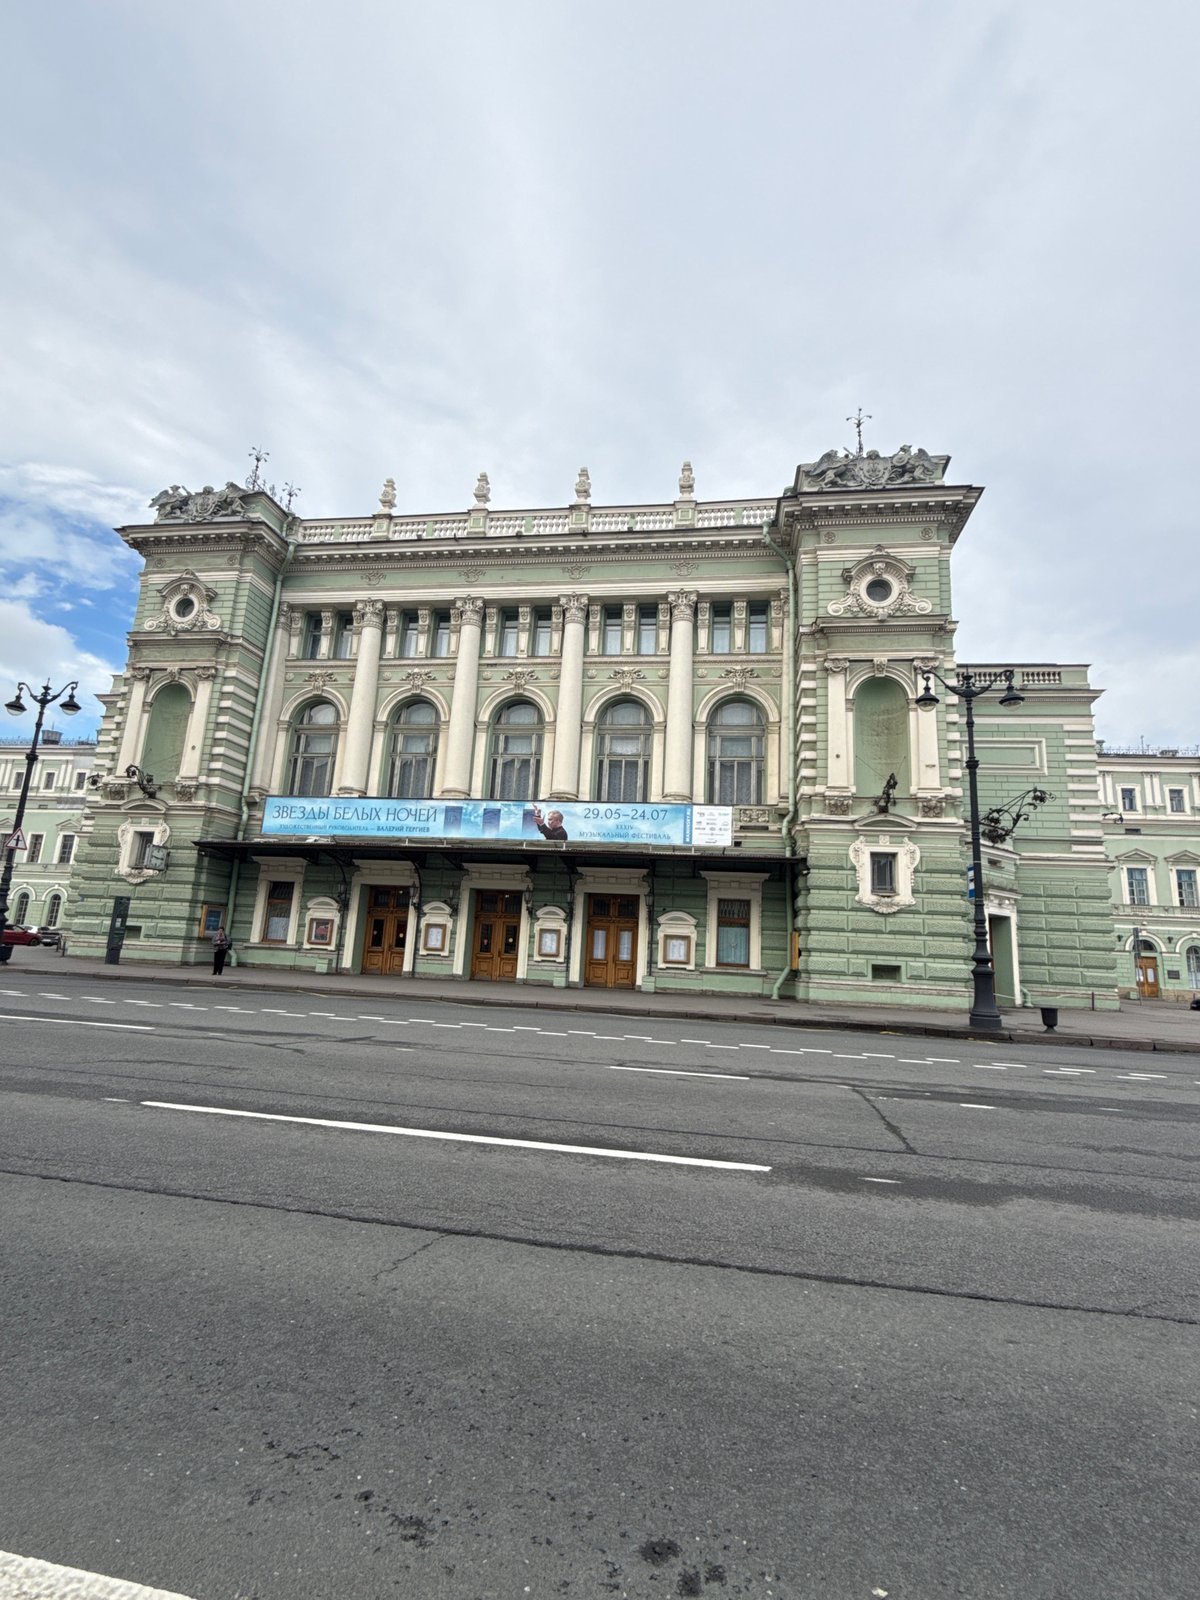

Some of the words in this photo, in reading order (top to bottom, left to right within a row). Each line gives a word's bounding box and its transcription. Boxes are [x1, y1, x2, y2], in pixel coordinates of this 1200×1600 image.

[272, 805, 330, 820] ЗВЕЗДЫ
[333, 806, 382, 821] БЕЛЫХ
[385, 806, 438, 822] НОЧЕЙ
[328, 824, 368, 832] РУКОВОДИТЕЛЬ
[376, 824, 404, 833] ВАЛЕРИЙ
[579, 830, 630, 839] МУЗЫКАЛЬНЫЙ
[631, 832, 671, 840] ФЕСТИВАЛЬ
